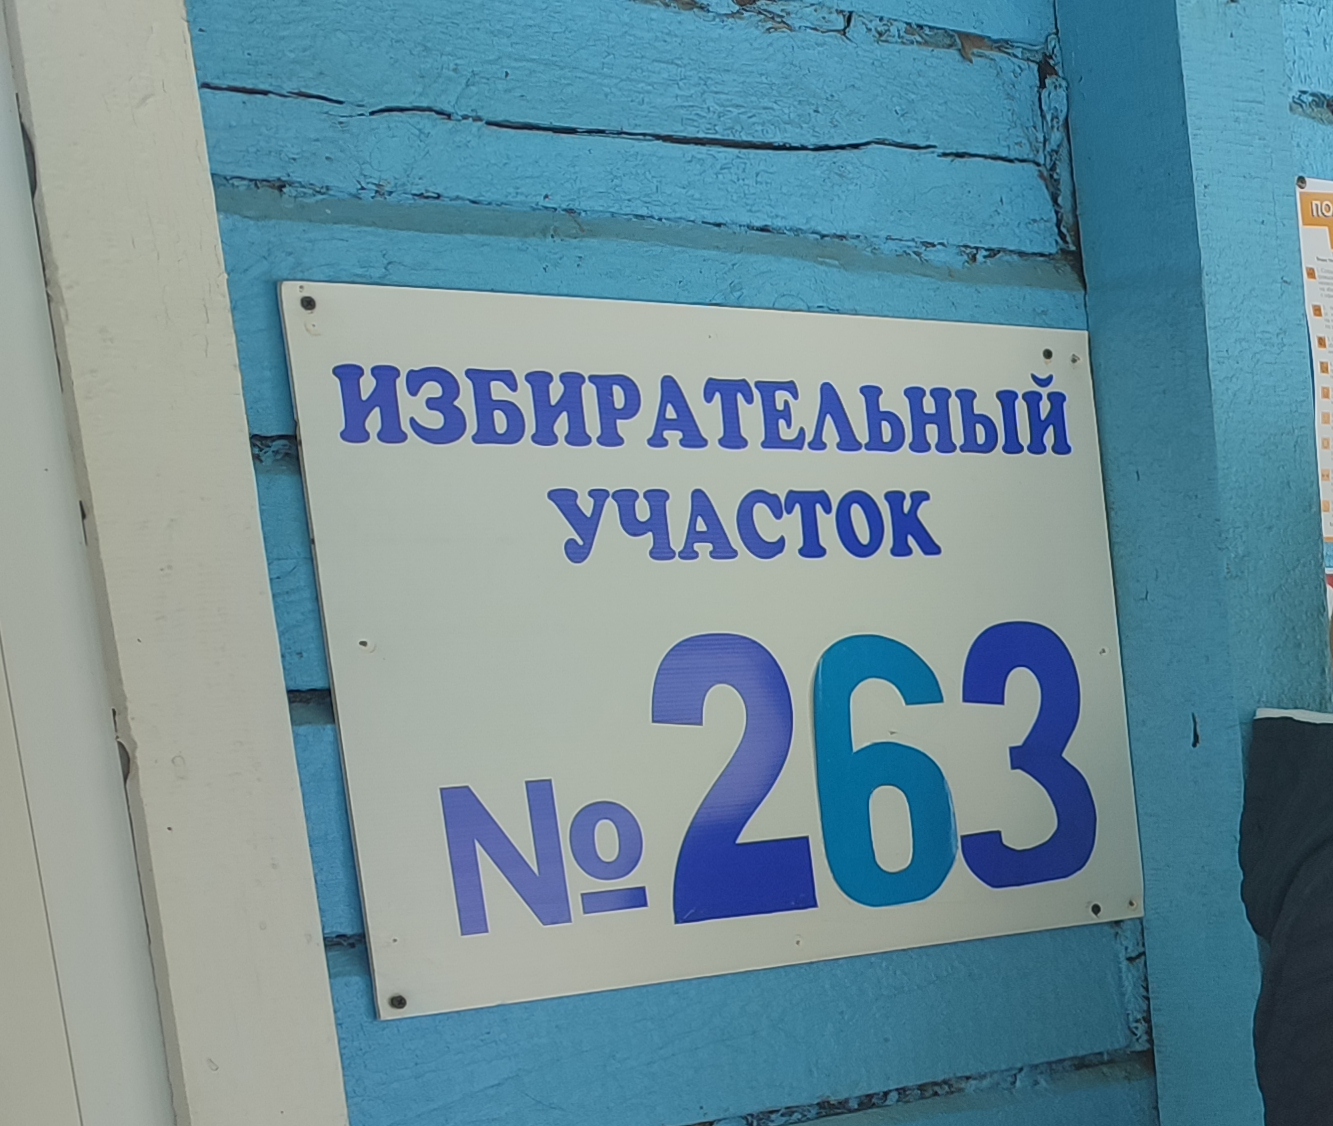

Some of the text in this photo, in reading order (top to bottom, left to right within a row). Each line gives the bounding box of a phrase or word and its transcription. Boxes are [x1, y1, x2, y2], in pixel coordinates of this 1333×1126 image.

[332, 363, 1072, 455] ИЗБИРАТЕЛЬНЫЙ
[547, 488, 942, 564] УЧАСТОК
[439, 621, 1098, 936] № 263
